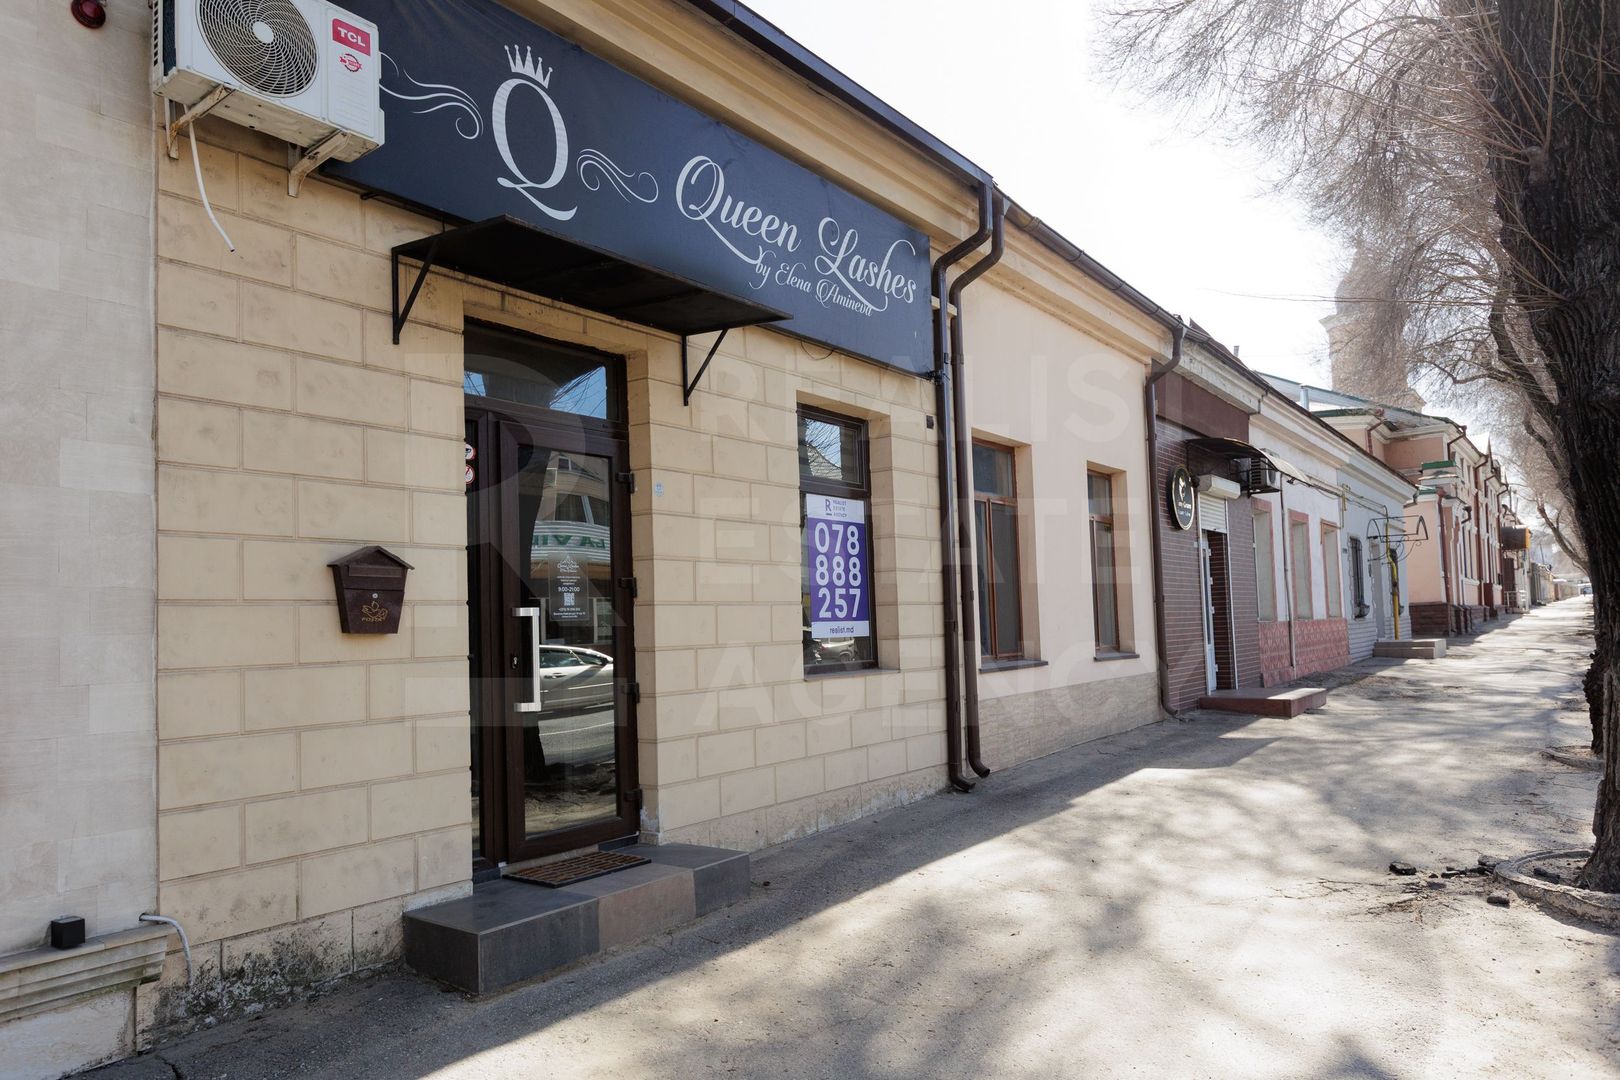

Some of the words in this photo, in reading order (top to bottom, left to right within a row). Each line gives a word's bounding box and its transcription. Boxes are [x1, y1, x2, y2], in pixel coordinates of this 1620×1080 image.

[337, 27, 366, 47] TCL
[491, 78, 578, 221] Q
[675, 155, 801, 265] Queen
[814, 217, 917, 312] Lashes
[748, 245, 777, 290] by
[774, 262, 812, 293] Elena
[814, 521, 860, 556] 078
[815, 554, 862, 587] 888
[818, 587, 861, 619] 257
[829, 625, 855, 635] realist.md
